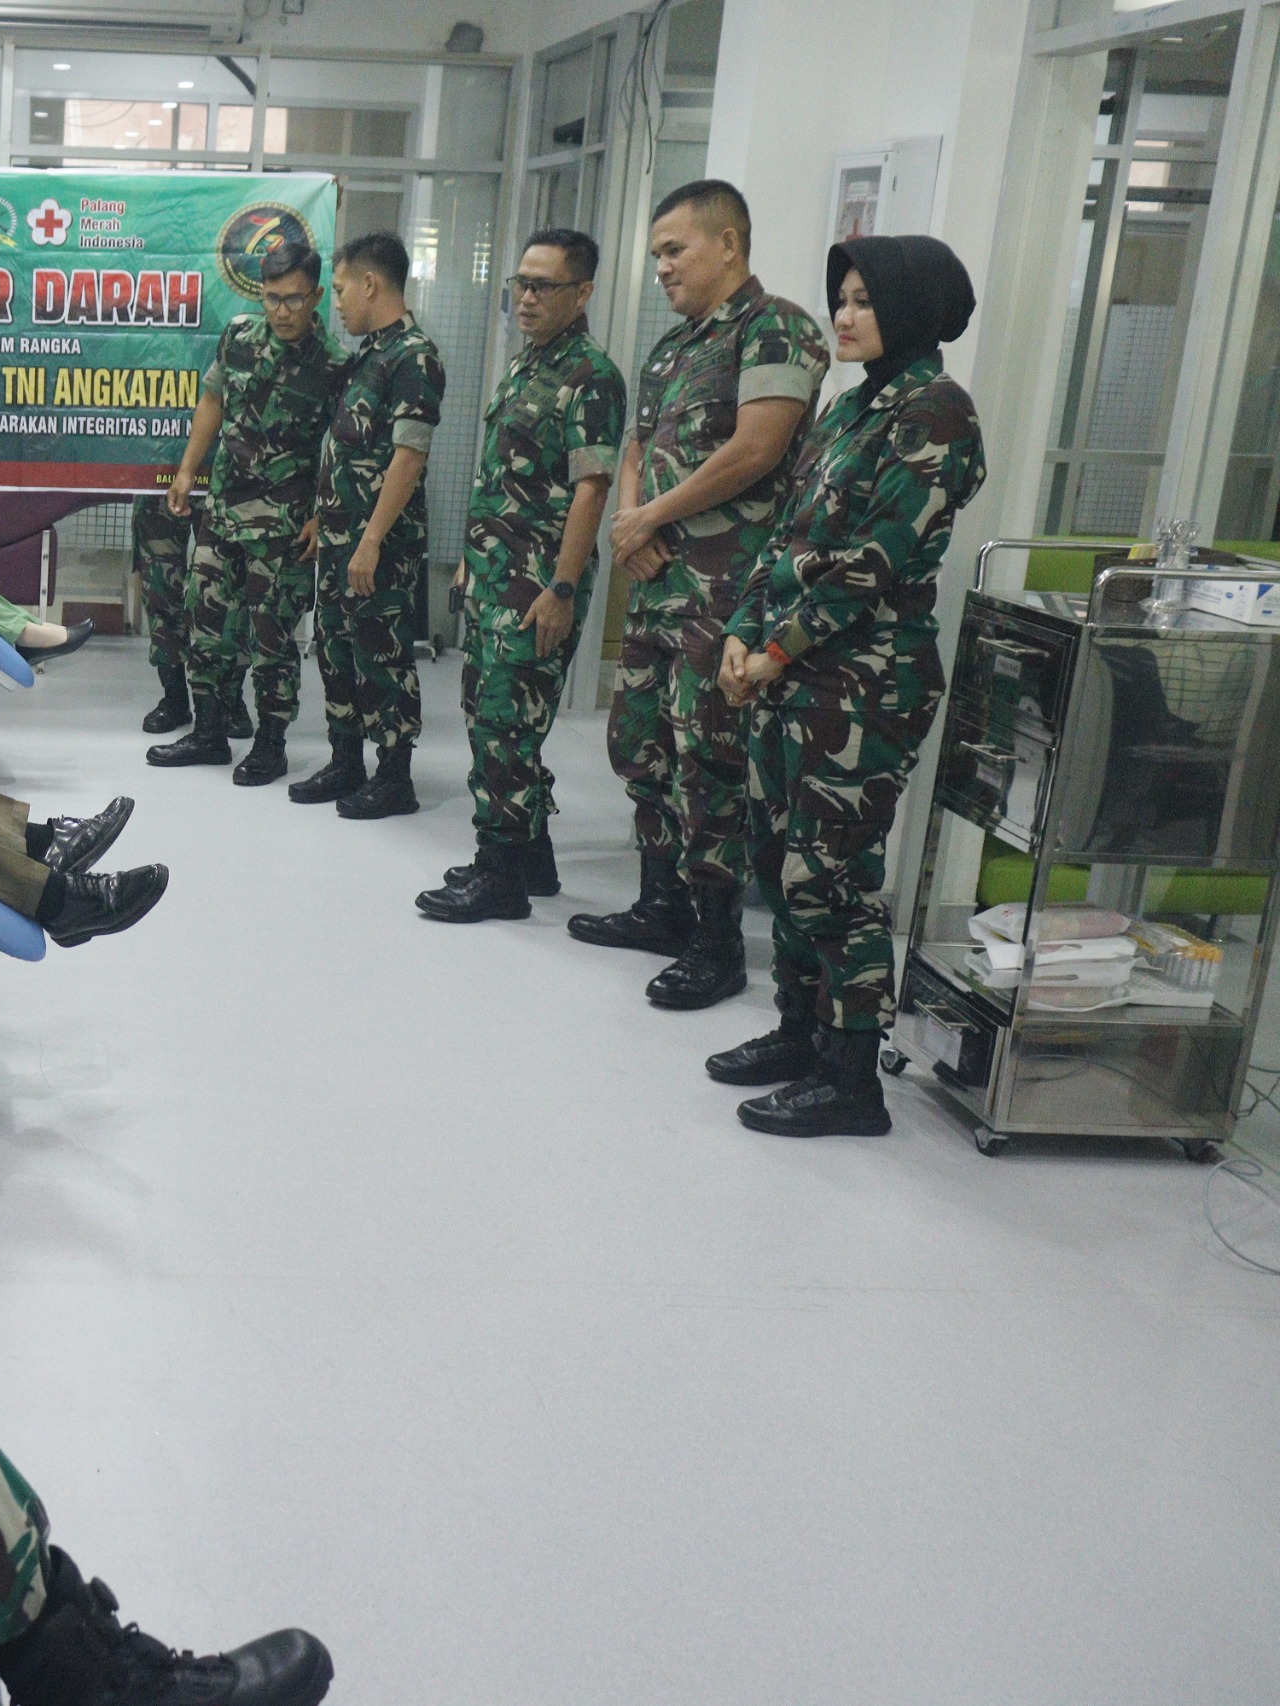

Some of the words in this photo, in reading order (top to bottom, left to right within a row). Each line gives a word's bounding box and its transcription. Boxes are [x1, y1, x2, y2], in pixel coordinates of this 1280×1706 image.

[79, 198, 125, 215] Palang
[79, 217, 120, 231] Merah
[79, 235, 144, 249] Indonesia
[32, 268, 202, 327] DARAH
[20, 338, 81, 355] RANGKA
[2, 365, 45, 406] TNI
[53, 368, 198, 409] ANGKATAN
[62, 416, 147, 436] INTEGRITAS
[151, 418, 181, 437] DAN
